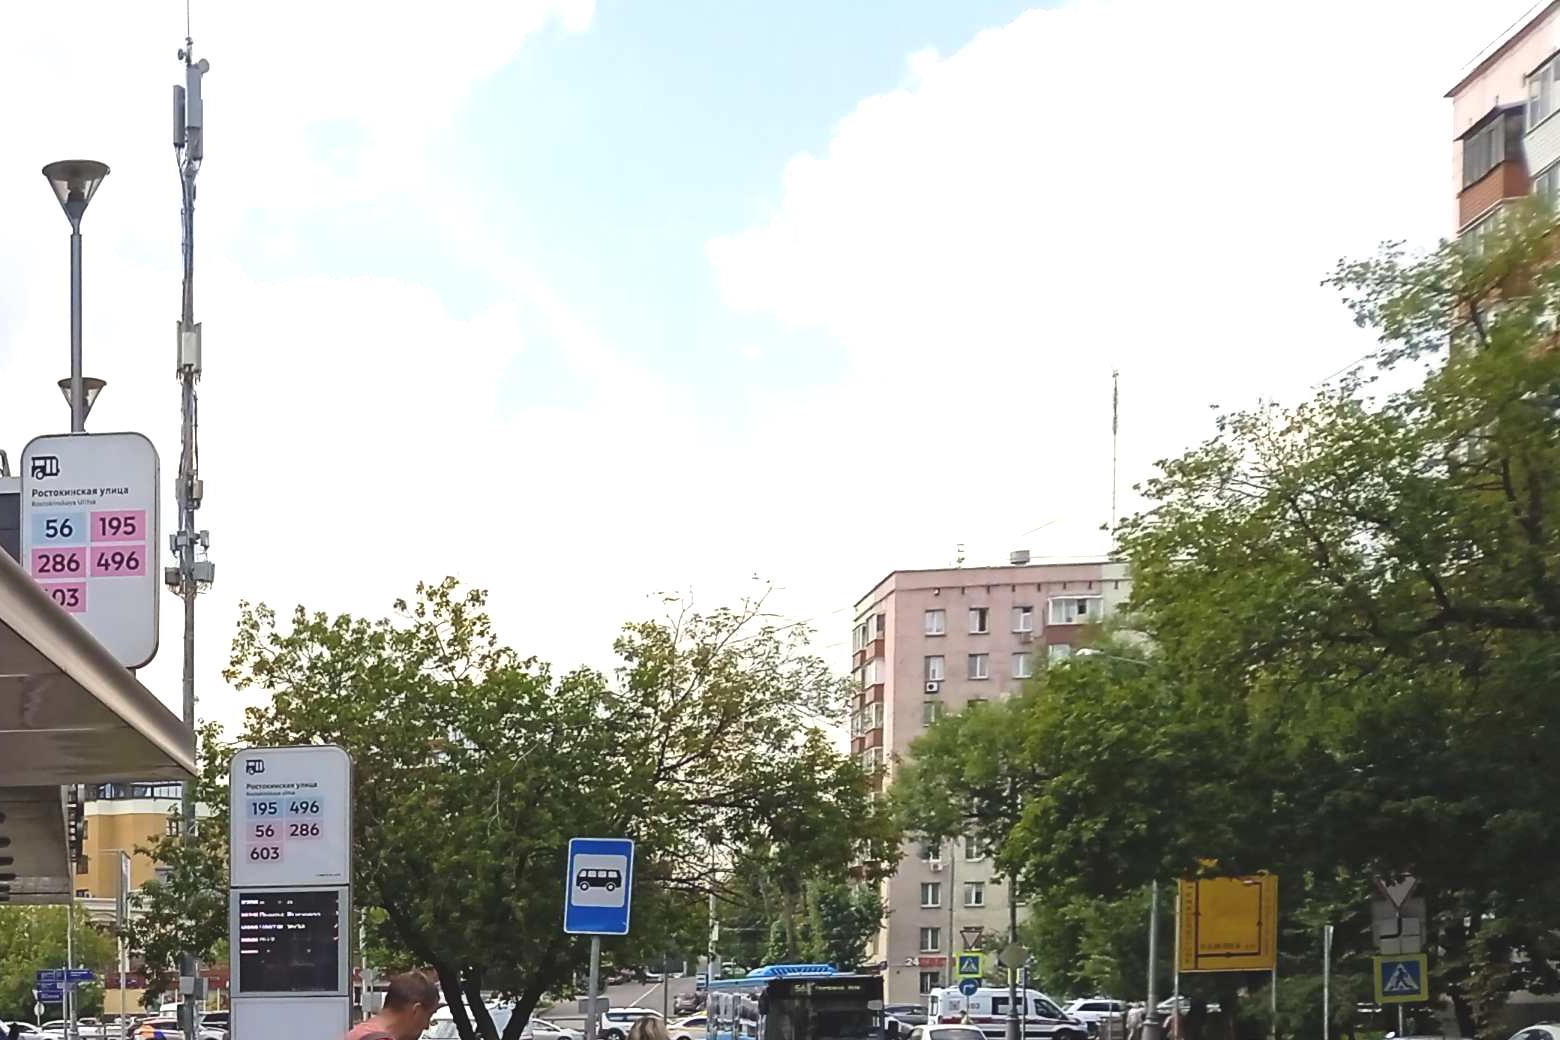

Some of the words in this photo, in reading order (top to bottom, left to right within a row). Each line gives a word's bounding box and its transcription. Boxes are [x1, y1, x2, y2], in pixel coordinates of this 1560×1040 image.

[31, 488, 98, 498] Ростокинская
[100, 487, 129, 497] улица
[45, 518, 74, 538] 56
[99, 516, 137, 537] 195
[37, 553, 81, 574] 286
[96, 551, 140, 572] 496
[45, 587, 80, 607] 03
[251, 801, 278, 816] 195
[289, 800, 320, 815] 496
[255, 824, 275, 838] 56
[289, 823, 320, 837] 286
[250, 847, 280, 860] 603
